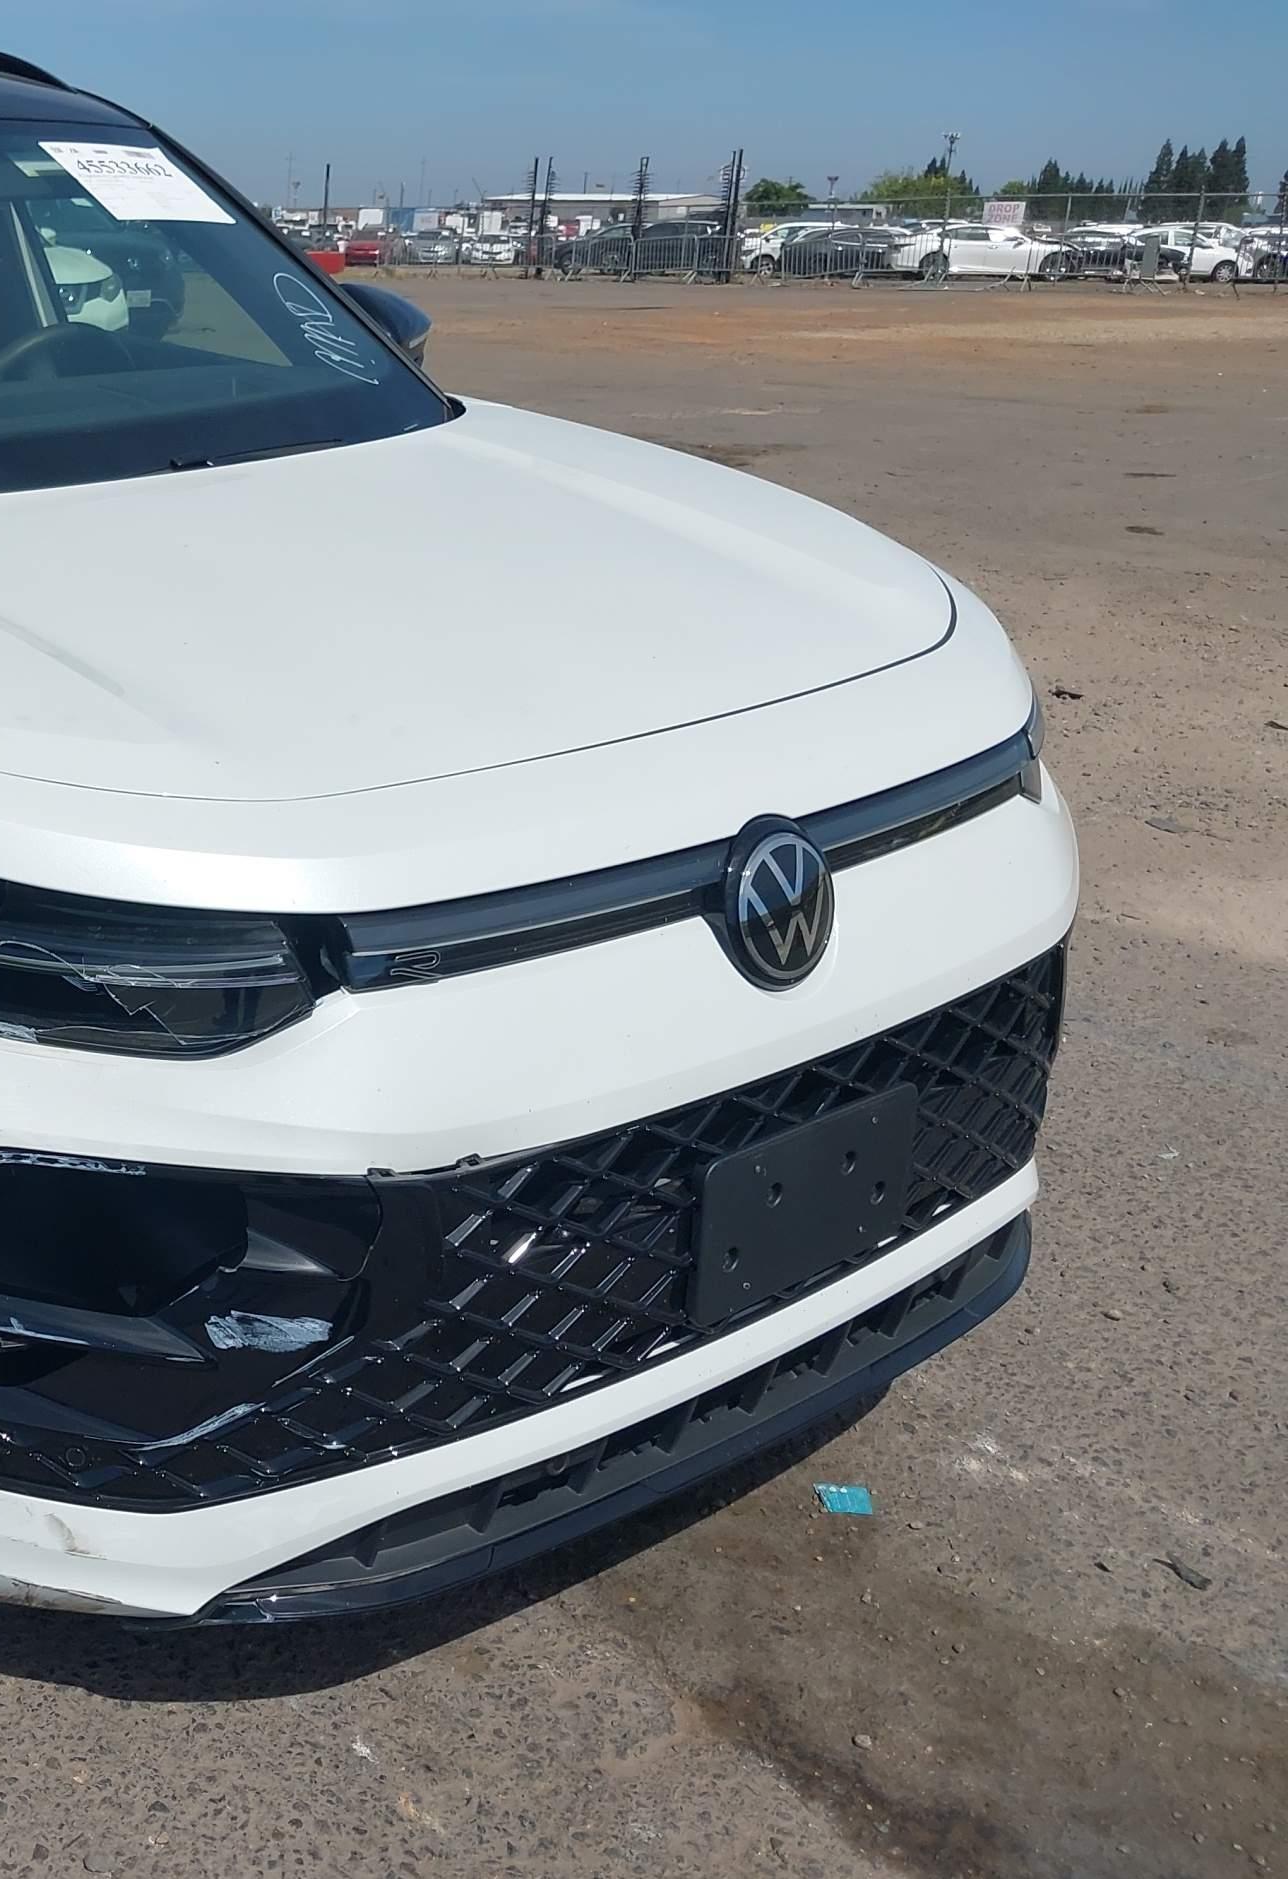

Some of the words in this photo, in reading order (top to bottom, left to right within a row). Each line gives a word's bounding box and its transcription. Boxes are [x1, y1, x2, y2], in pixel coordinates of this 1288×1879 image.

[76, 159, 173, 177] 45533662
[988, 203, 1020, 214] DROP
[987, 215, 1019, 224] ZONE
